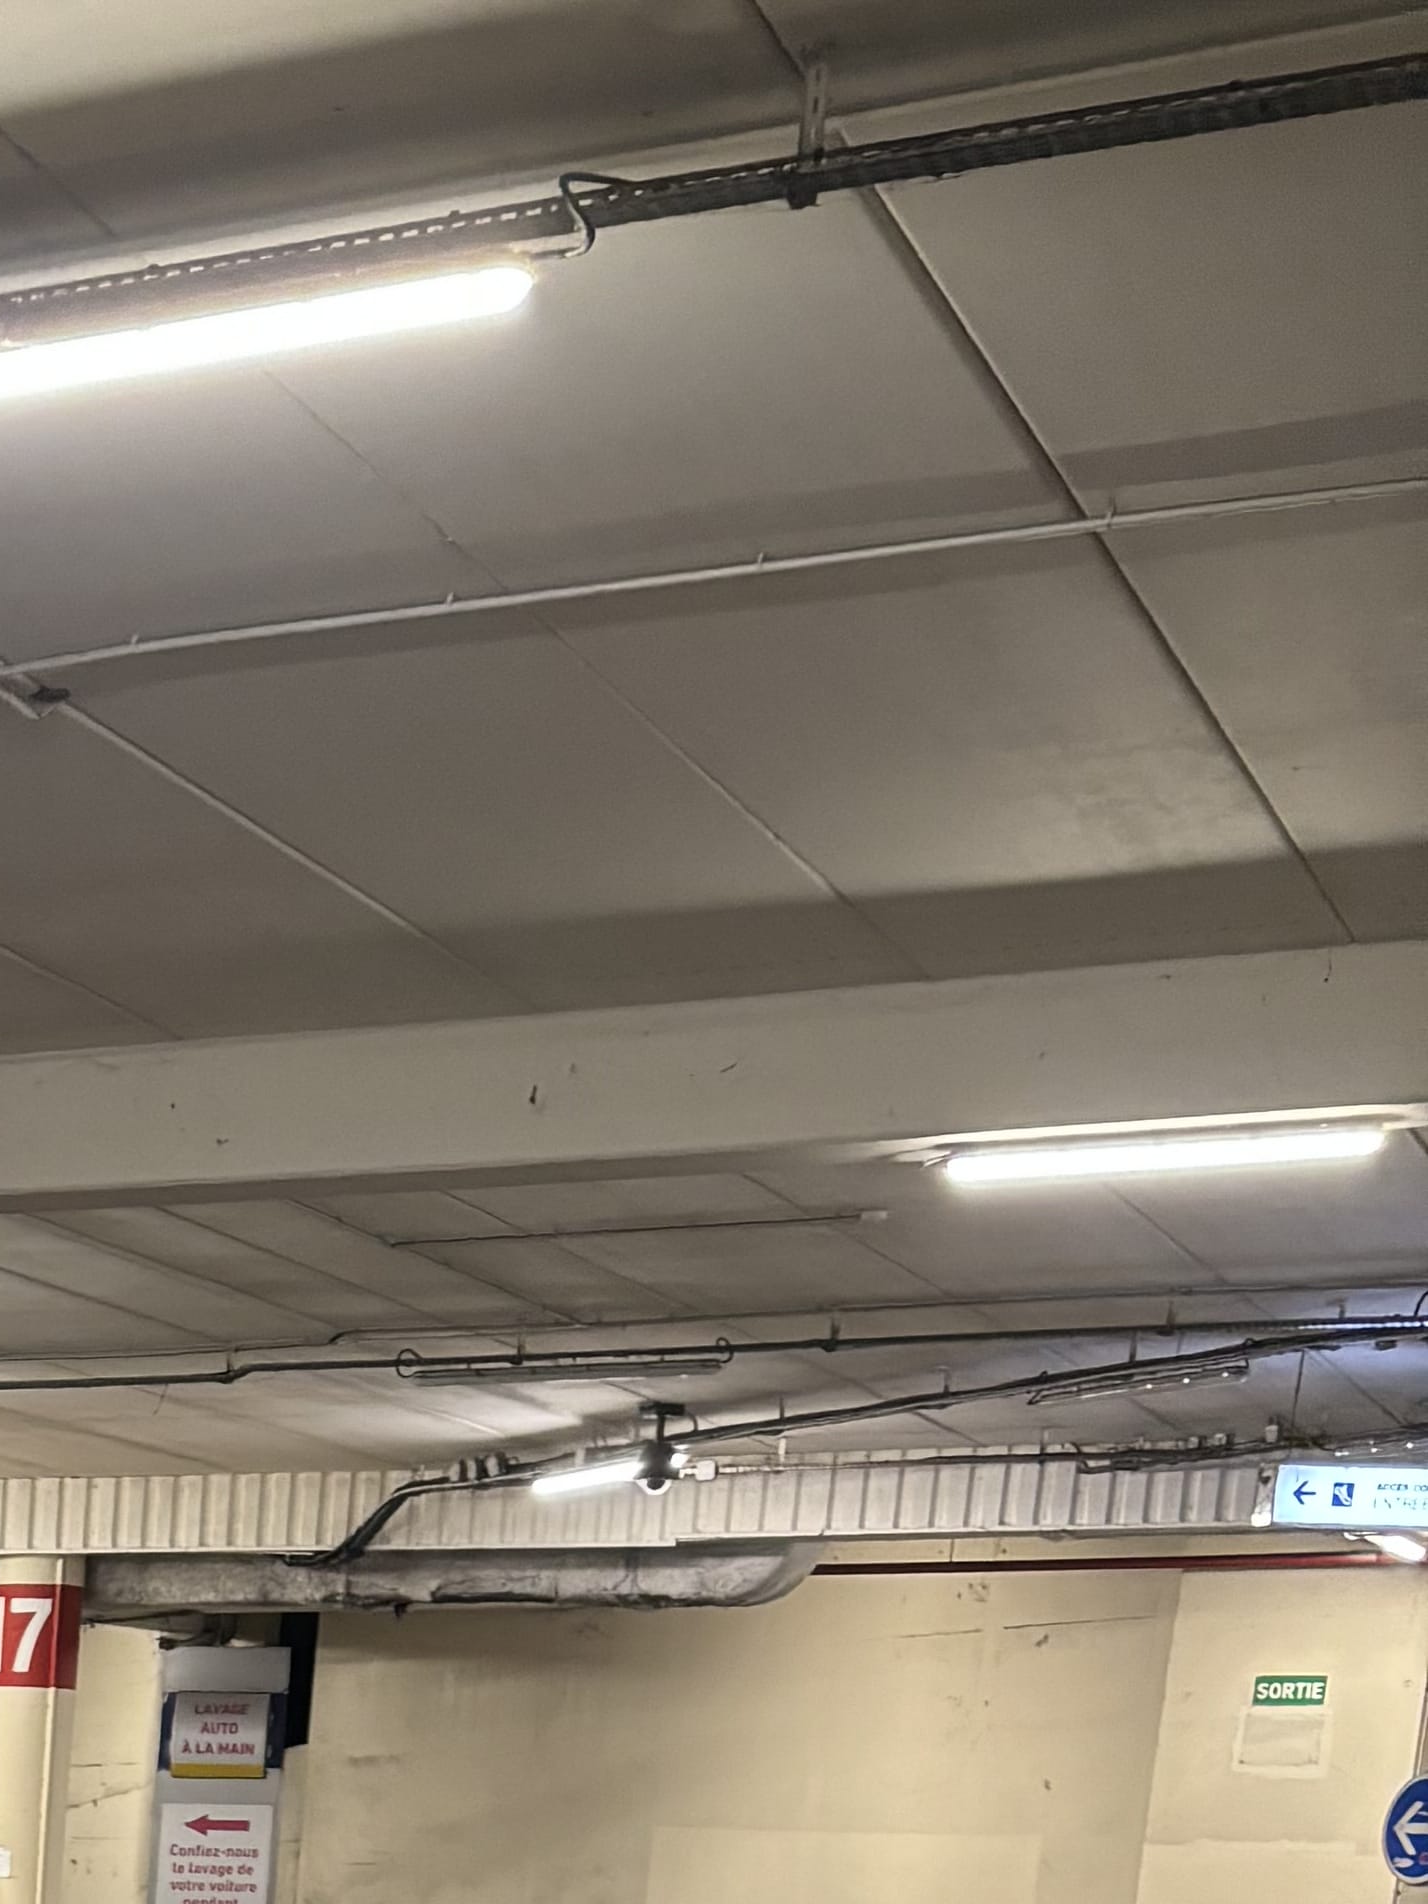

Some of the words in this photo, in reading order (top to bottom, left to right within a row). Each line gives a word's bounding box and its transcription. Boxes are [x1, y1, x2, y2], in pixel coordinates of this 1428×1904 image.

[1256, 1682, 1324, 1699] SORTIE
[195, 1703, 250, 1715] LAVAGE
[201, 1722, 239, 1734] AUTO
[182, 1739, 192, 1754] À
[195, 1743, 214, 1754] LA
[217, 1743, 255, 1755] MAIN
[170, 1843, 259, 1858] Confiez-nous
[172, 1862, 185, 1874] le
[189, 1862, 233, 1877] lavage
[237, 1864, 254, 1875] de
[169, 1881, 205, 1891] votre
[209, 1880, 258, 1892] voiture
